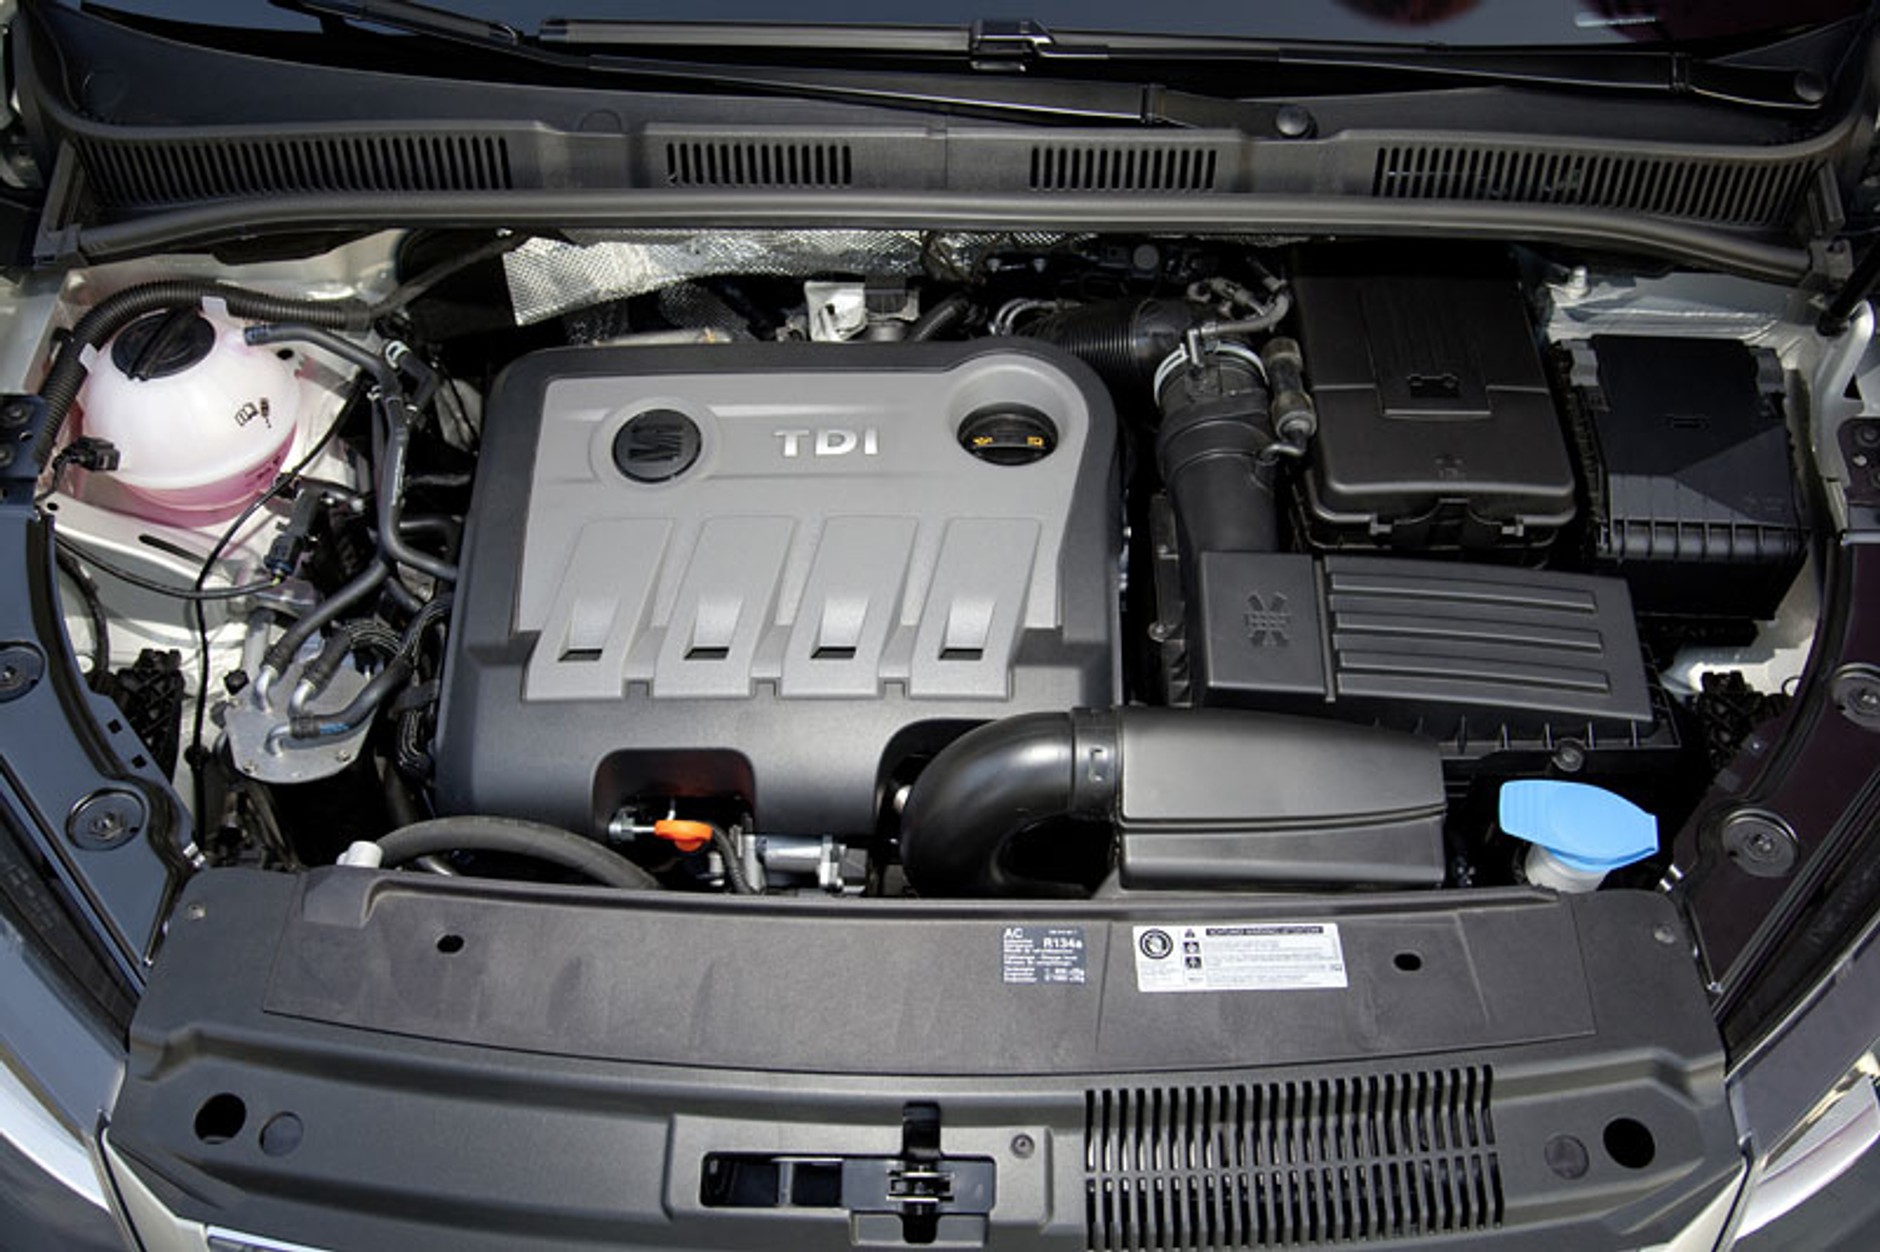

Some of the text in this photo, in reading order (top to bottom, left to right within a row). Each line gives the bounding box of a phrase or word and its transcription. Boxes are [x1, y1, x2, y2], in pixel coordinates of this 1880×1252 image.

[774, 429, 878, 457] TDI
[1003, 928, 1023, 938] AC
[1043, 937, 1083, 949] R134a
